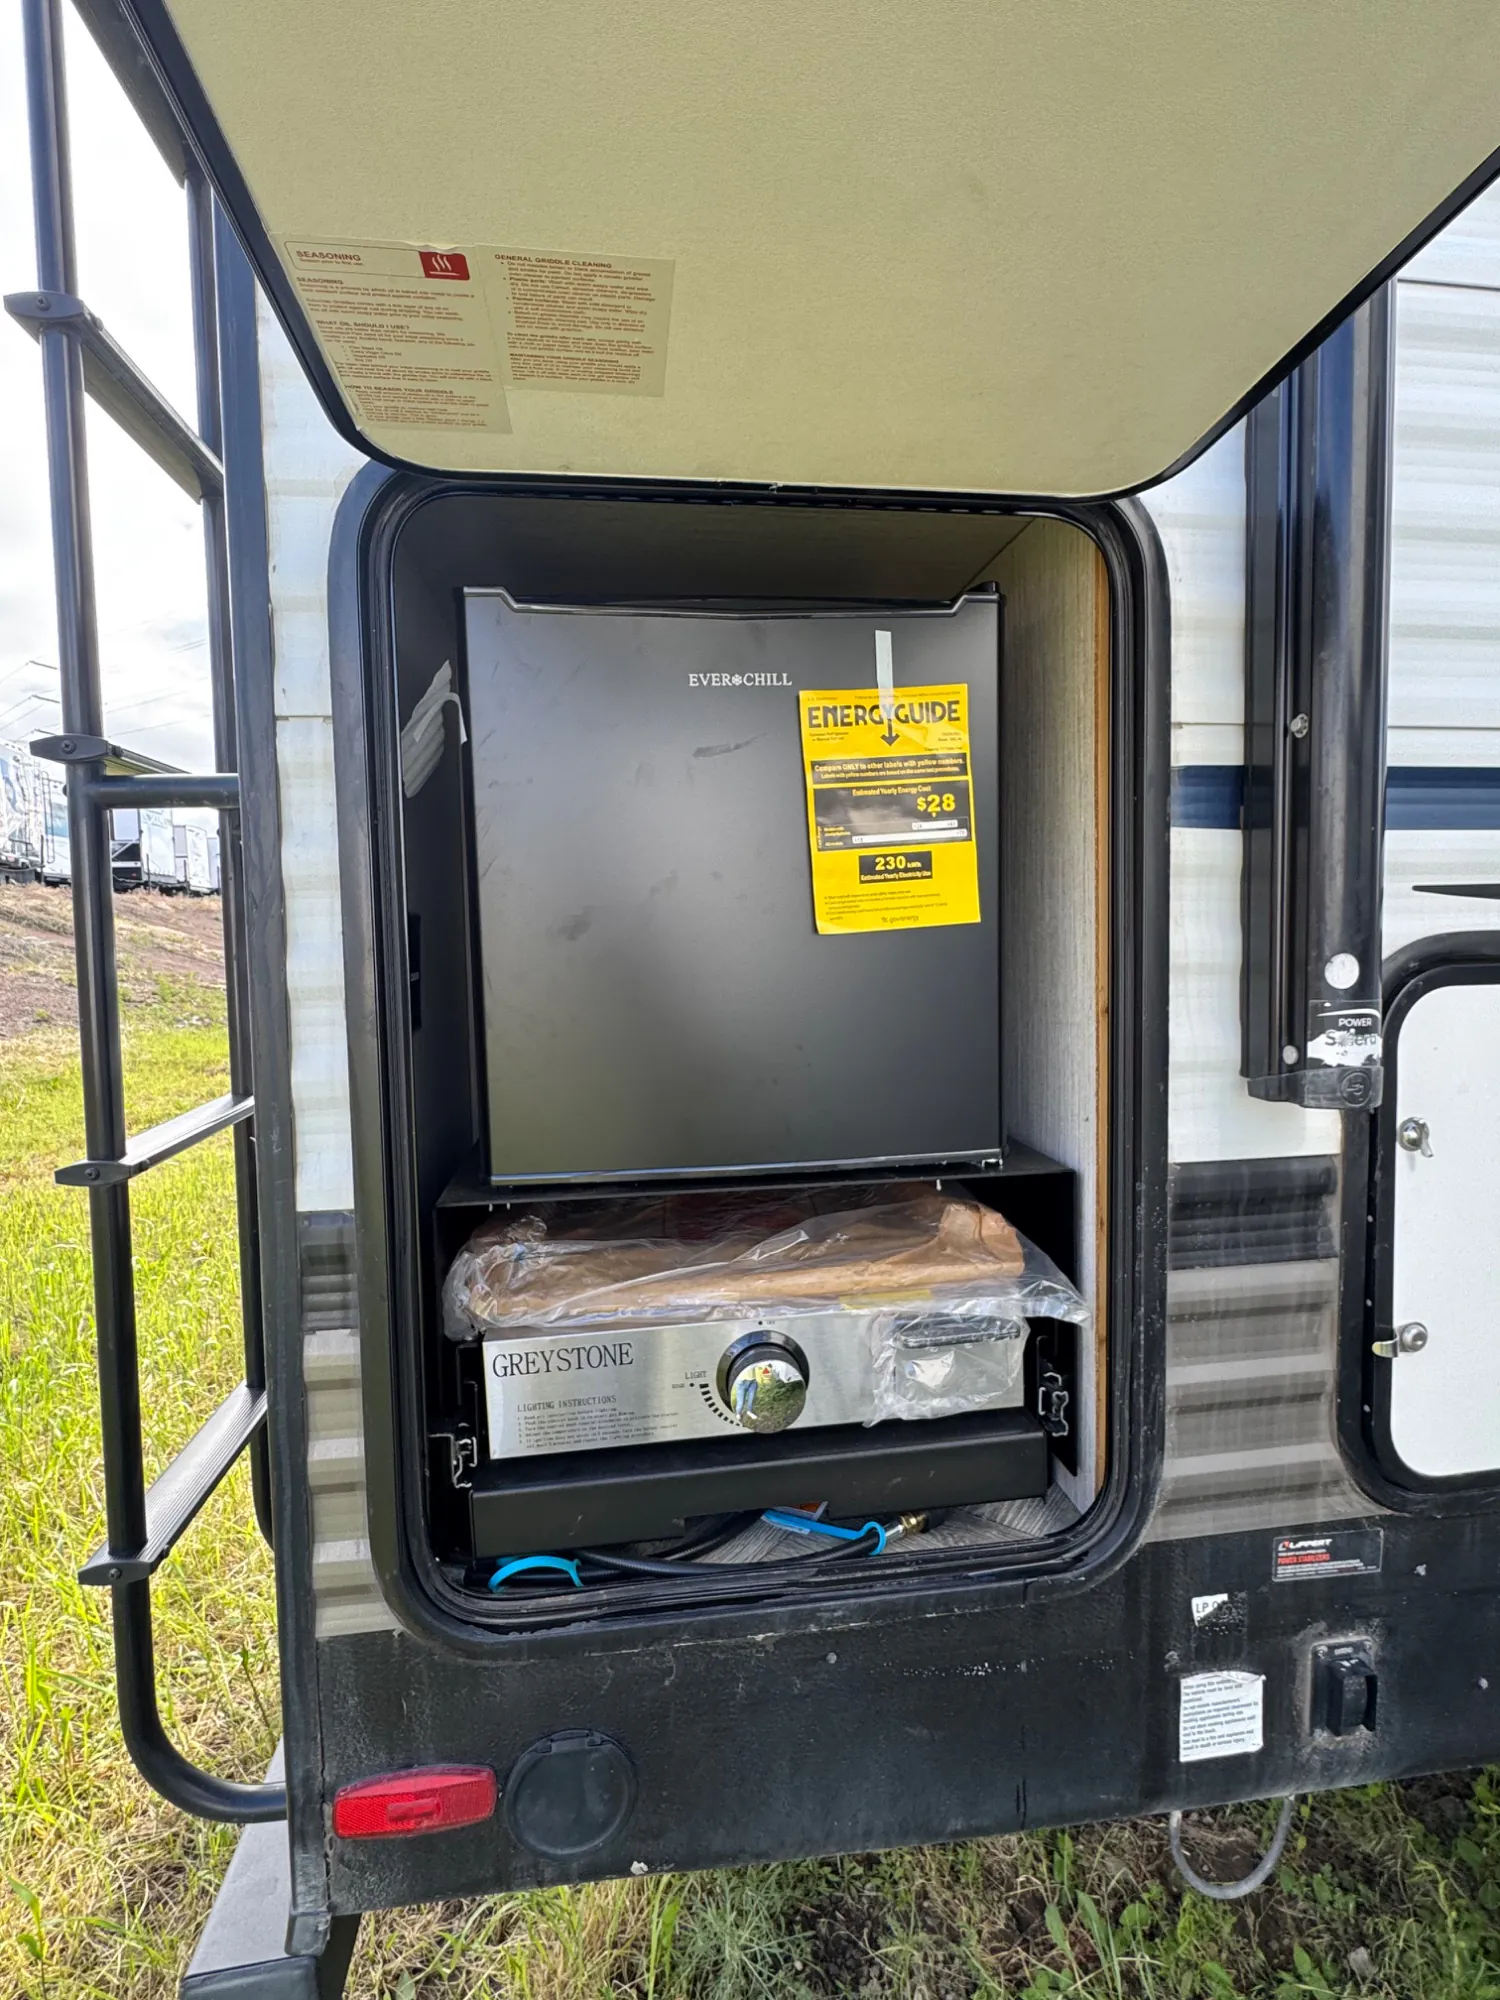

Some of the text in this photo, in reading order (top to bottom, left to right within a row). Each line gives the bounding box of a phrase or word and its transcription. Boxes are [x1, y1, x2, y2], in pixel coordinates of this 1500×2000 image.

[295, 250, 362, 261] SEASONING
[494, 254, 612, 268] GENERAL GRIDDLE CLEANING
[688, 673, 792, 686] EVER CHILL
[814, 764, 841, 773] Compare
[842, 763, 860, 771] ONLY
[867, 761, 884, 769] other
[884, 760, 903, 769] labels
[903, 759, 917, 767] with
[917, 758, 937, 768] yellow
[852, 784, 932, 796] Estimated Yearly Energy Cost
[917, 793, 956, 812] $28
[875, 855, 906, 871] 230
[861, 873, 885, 881] Estimated
[1338, 1017, 1373, 1027] POWER
[492, 1342, 634, 1378] GREYSTONE
[684, 1370, 707, 1380] LIGHT
[517, 1395, 617, 1413] LIGHTING INSTRUCTIONS
[1196, 1602, 1209, 1613] LP
